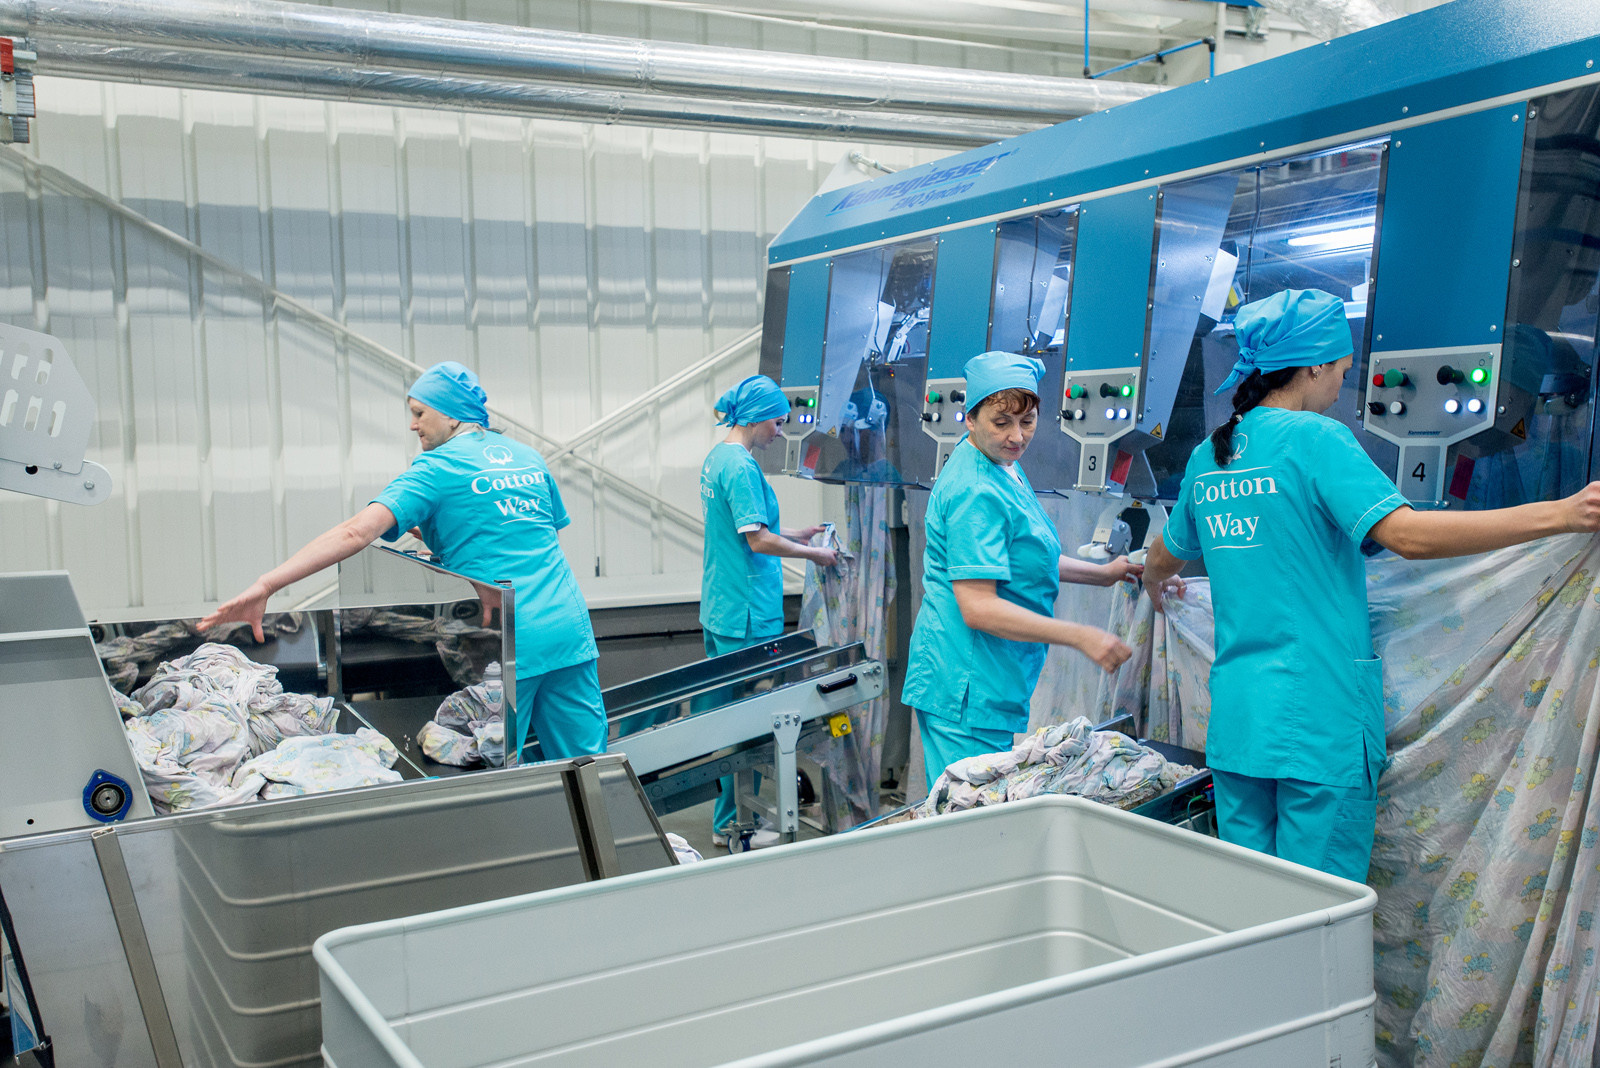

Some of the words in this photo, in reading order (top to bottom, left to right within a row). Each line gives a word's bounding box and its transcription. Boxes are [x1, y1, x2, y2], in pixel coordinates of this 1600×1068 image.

[831, 151, 1011, 213] Kannegiesser
[1088, 455, 1097, 471] 3
[1411, 461, 1426, 482] 4
[471, 471, 546, 495] Cotton
[1193, 476, 1279, 505] Cotton
[493, 496, 541, 517] Way
[1205, 512, 1260, 542] Way
